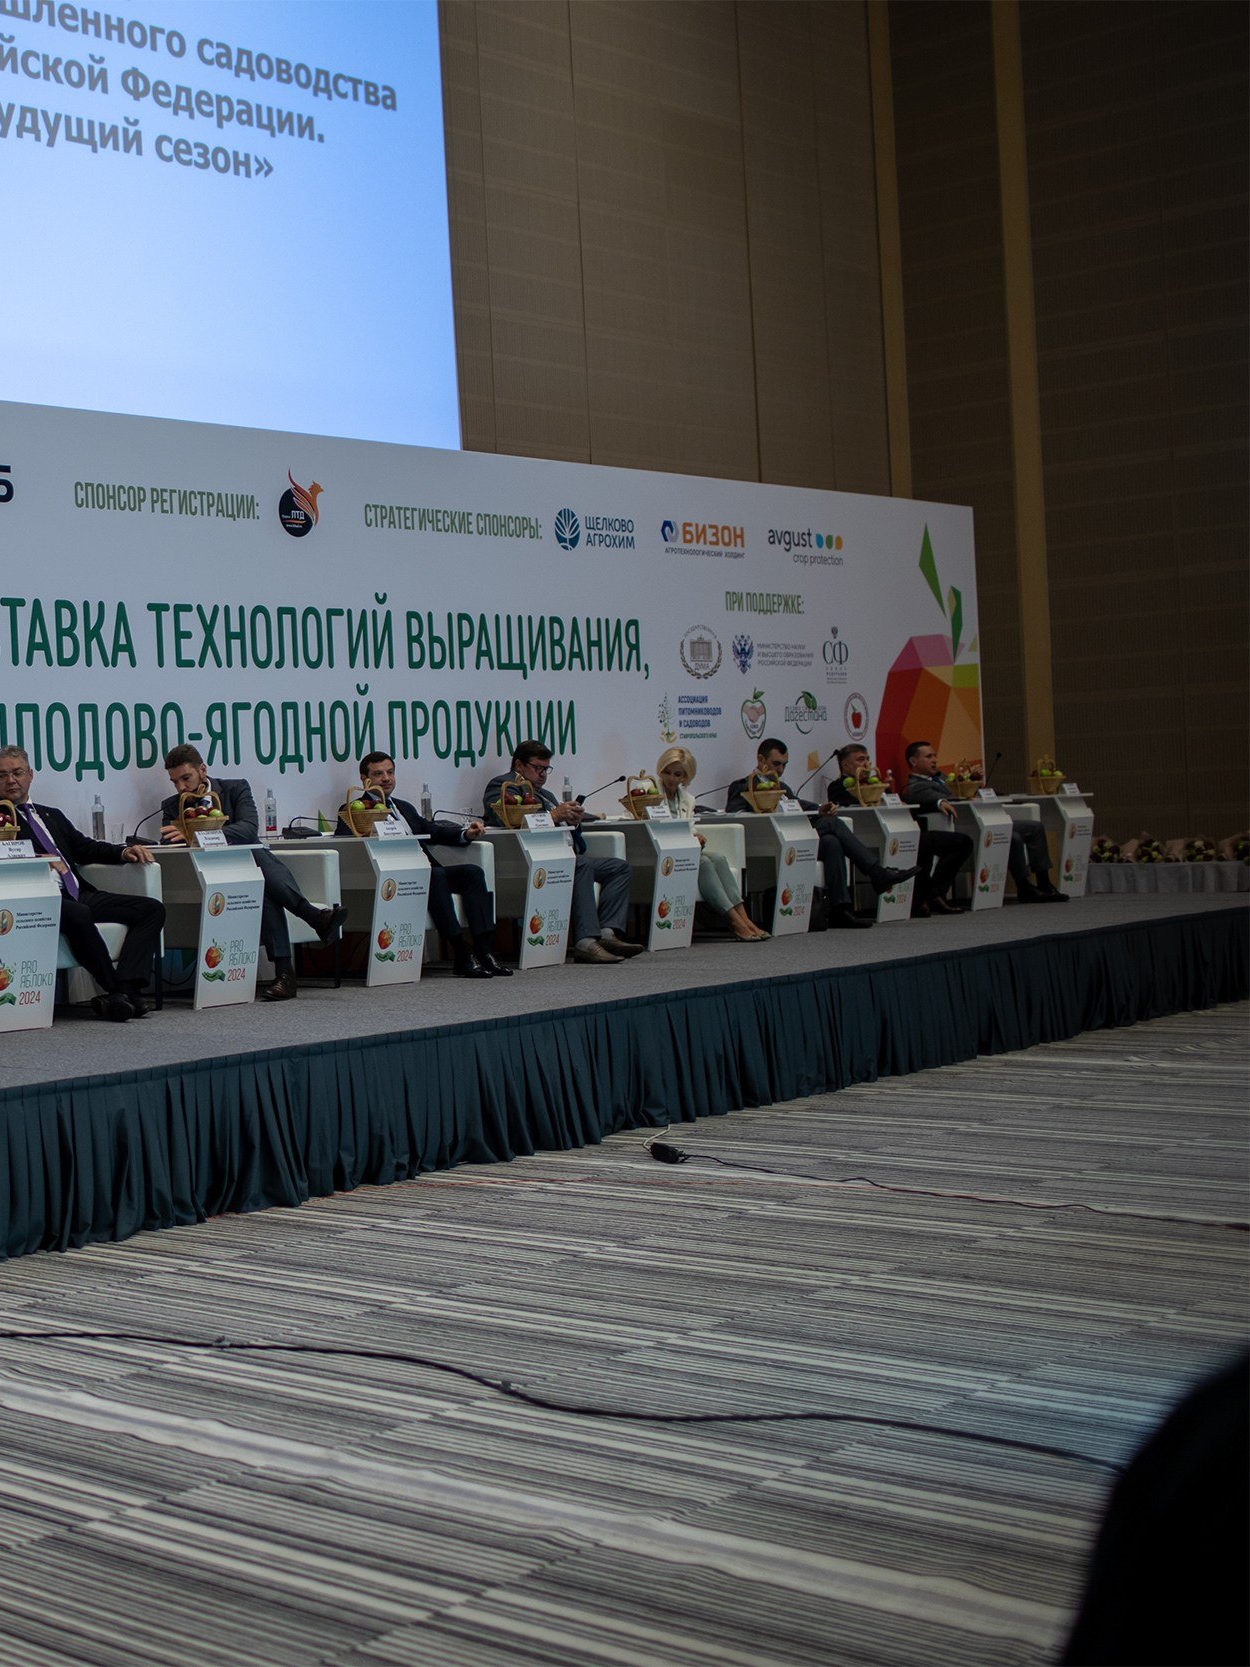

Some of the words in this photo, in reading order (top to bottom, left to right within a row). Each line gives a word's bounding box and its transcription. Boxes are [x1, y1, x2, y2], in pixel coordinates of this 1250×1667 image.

[197, 37, 398, 111] садоводства
[121, 67, 326, 143] Федерации.
[155, 134, 274, 179] сезон»
[74, 481, 147, 514] СПОНСОР
[151, 487, 260, 521] РЕГИСТРАЦИИ:
[365, 503, 473, 535] СТРАТЕГИЧЕСКИЕ
[476, 514, 543, 540] СПОНСОРЫ:
[585, 516, 634, 533] ЩЕЛКОВО
[586, 534, 635, 549] АГРОХИМ
[682, 522, 745, 548] БИЗОН
[768, 528, 813, 552] avgust
[793, 553, 808, 565] crop
[810, 554, 844, 566] protection
[725, 591, 744, 612] ПРИ
[746, 592, 805, 615] ПОДДЕРЖКЕ:
[147, 592, 395, 670] ТЕХНОЛОГИЙ
[407, 610, 650, 680] ВЫРАЩИВАНИЯ,
[823, 640, 849, 665] СФ
[389, 700, 577, 769] ПРОДУКЦИИ
[230, 939, 244, 953] PRO
[21, 959, 37, 975] PRO
[228, 951, 256, 966] ЯБЛОКО
[20, 972, 53, 989] ЯБЛОКО
[227, 968, 246, 982] 2024
[19, 990, 41, 1006] 2024
